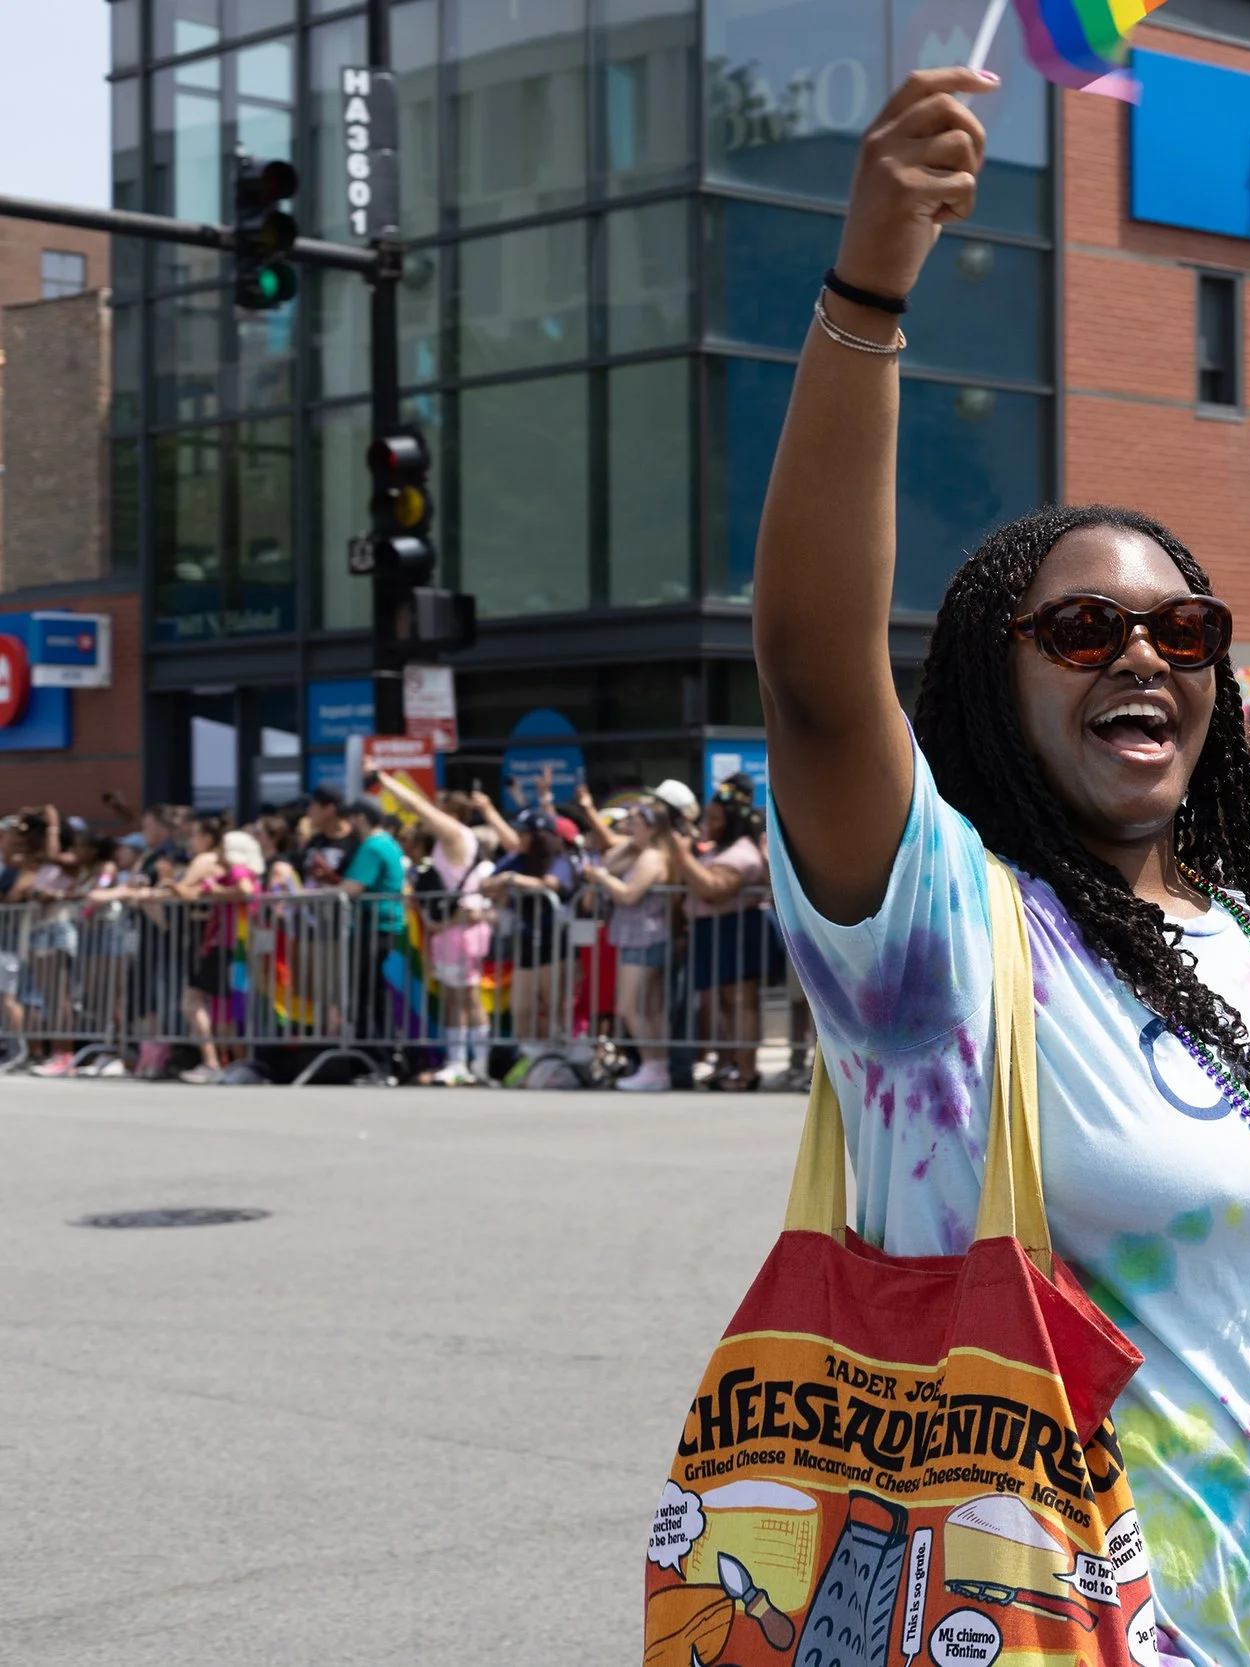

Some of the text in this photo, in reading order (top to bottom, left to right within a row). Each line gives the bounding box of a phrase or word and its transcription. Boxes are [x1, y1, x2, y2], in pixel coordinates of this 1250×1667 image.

[344, 68, 371, 235] HA3601
[825, 1355, 944, 1402] TADER JOE
[685, 1455, 734, 1481] Grilled
[736, 1449, 786, 1468] Cheese
[793, 1447, 846, 1477] Macaro
[922, 1463, 1025, 1493] Cheeseburger
[1030, 1482, 1091, 1529] Nachos
[660, 1501, 687, 1517] wheel
[653, 1516, 682, 1533] excited
[655, 1534, 666, 1547] be
[667, 1532, 688, 1545] here.
[1084, 1560, 1096, 1576] To
[906, 1542, 926, 1642] This is so grate.
[1079, 1577, 1098, 1593] not
[1100, 1581, 1113, 1596] to
[956, 1628, 996, 1645] chiamo
[1136, 1630, 1149, 1645] Je
[945, 1643, 987, 1659] Fontina
